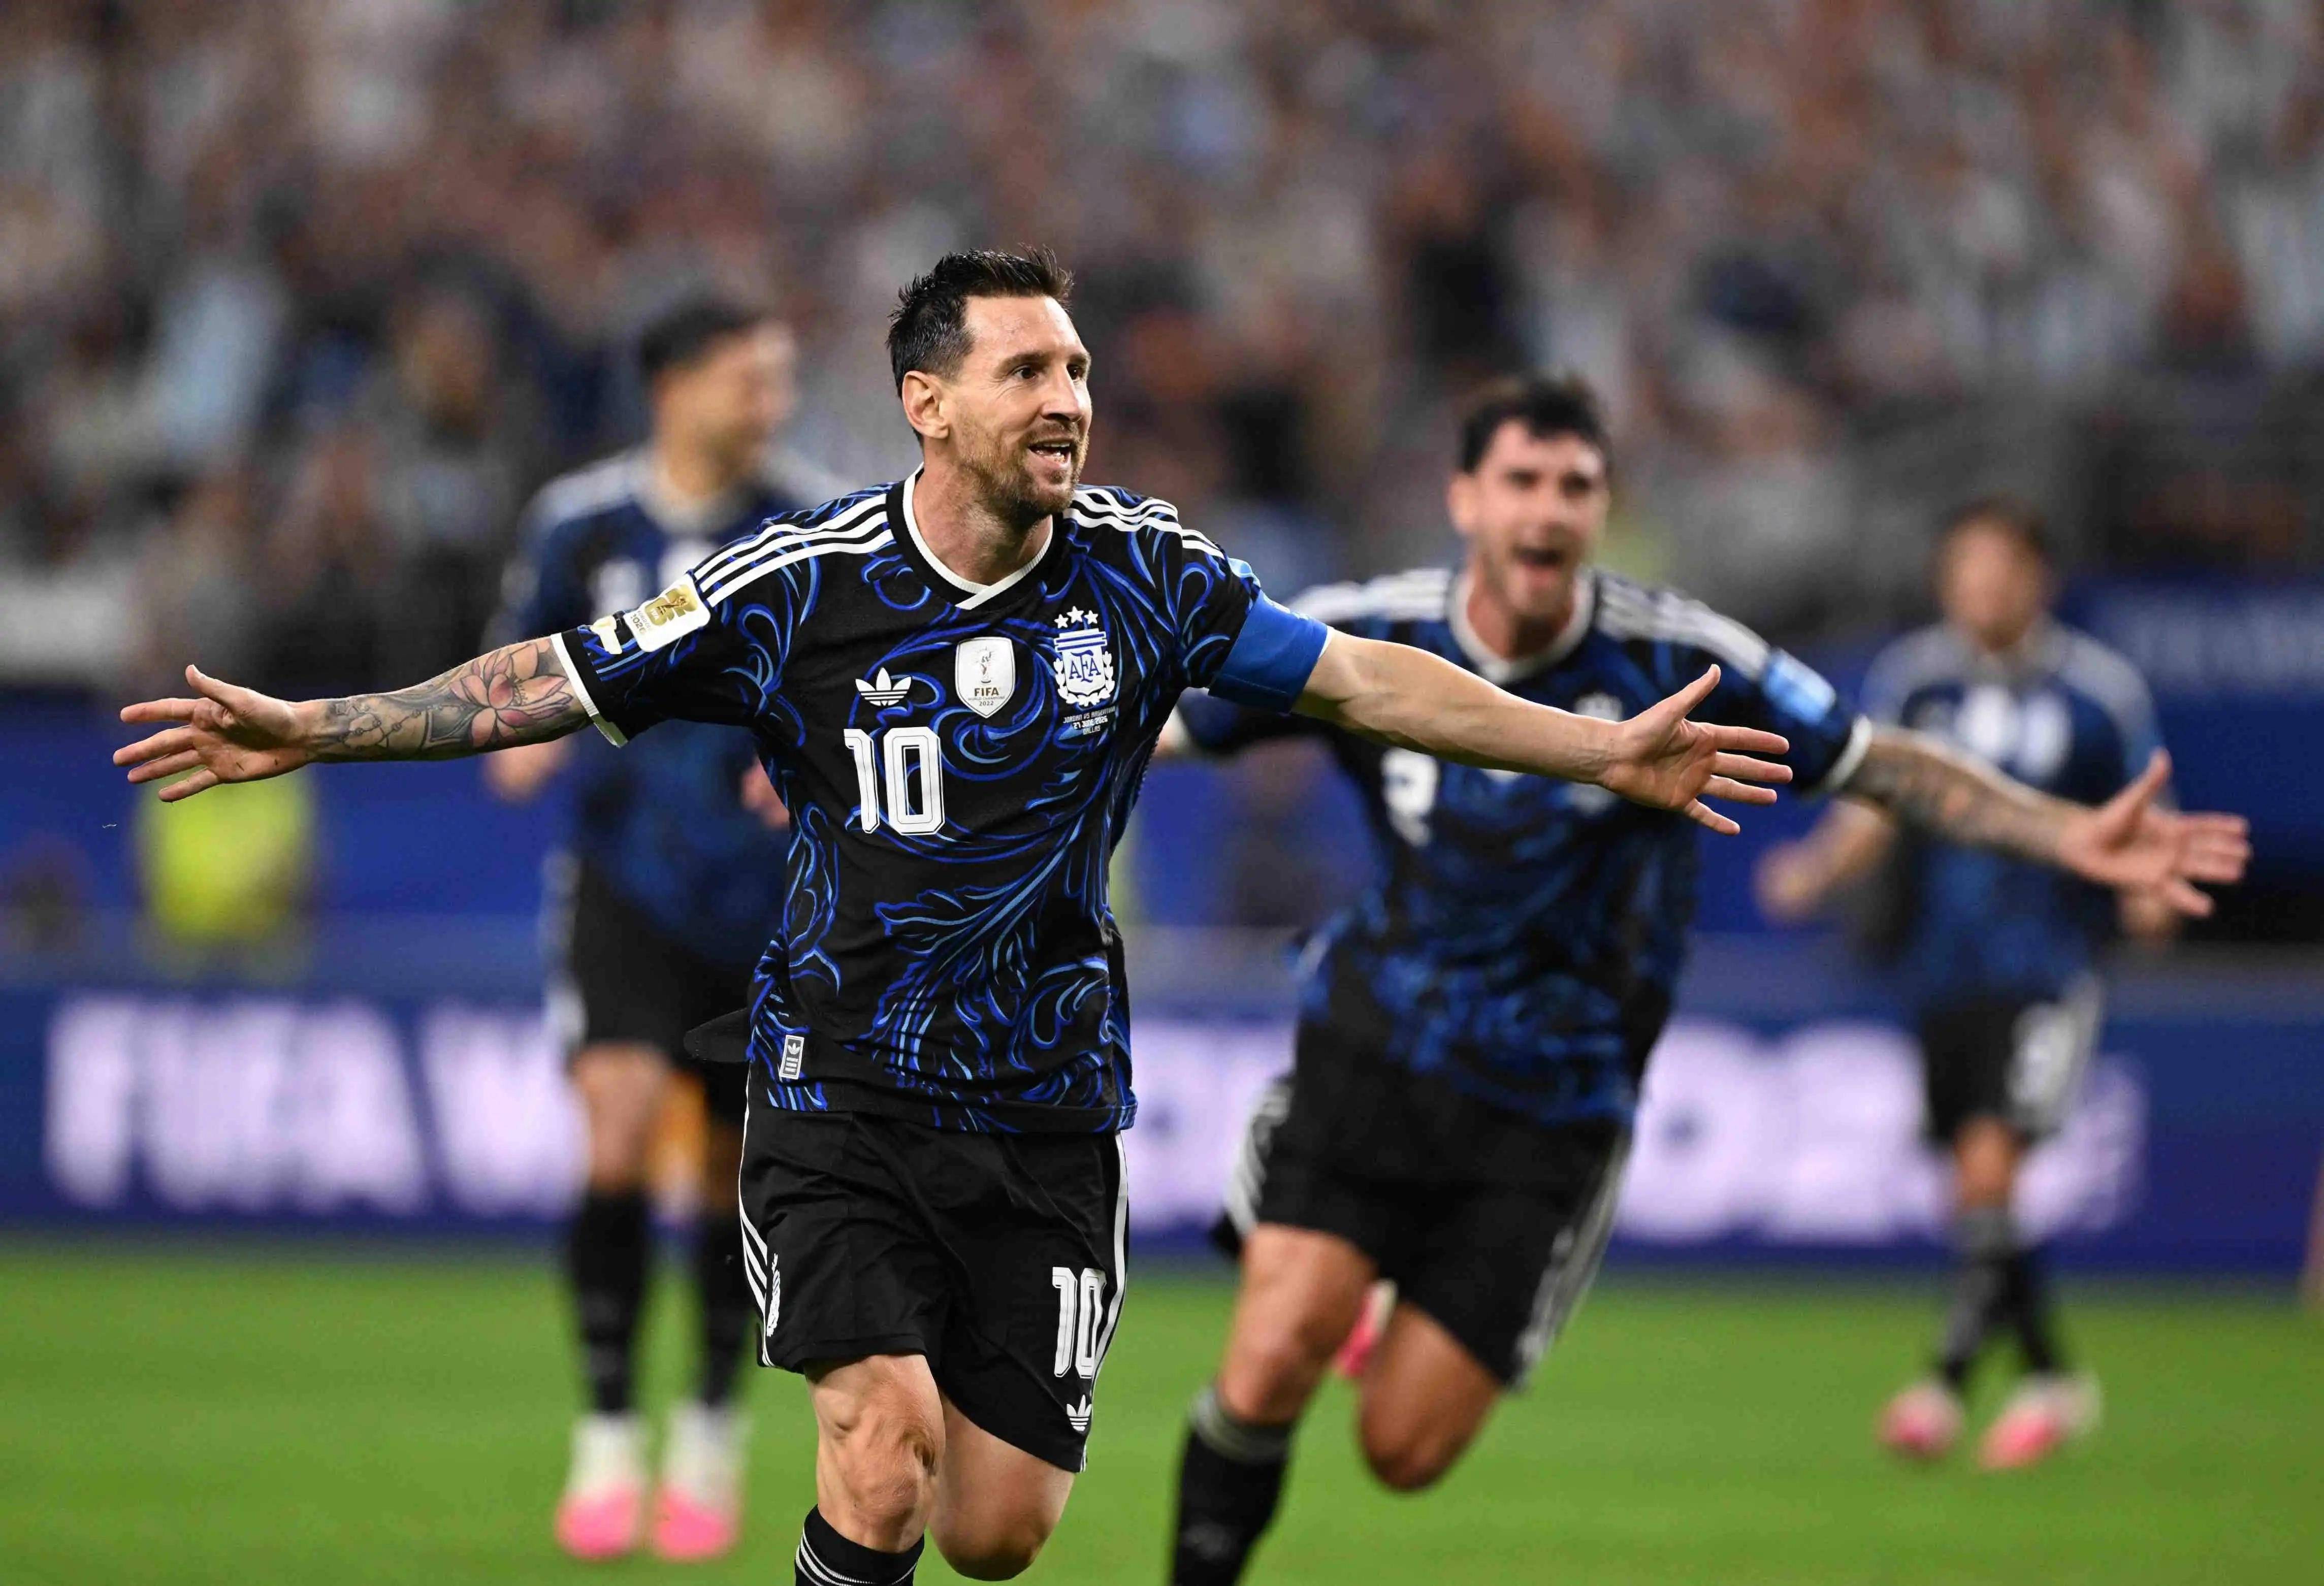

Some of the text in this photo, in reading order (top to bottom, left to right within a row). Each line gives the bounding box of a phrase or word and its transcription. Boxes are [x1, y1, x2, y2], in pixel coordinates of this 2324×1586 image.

[1069, 650, 1101, 683] AFA
[974, 687, 999, 696] FIFA
[1063, 714, 1082, 724] JORDAN
[1082, 719, 1095, 728] JUNE
[1094, 716, 1108, 724] 2026
[1083, 725, 1101, 735] DALLAS
[844, 727, 945, 836] 10
[1052, 1267, 1106, 1379] 10
